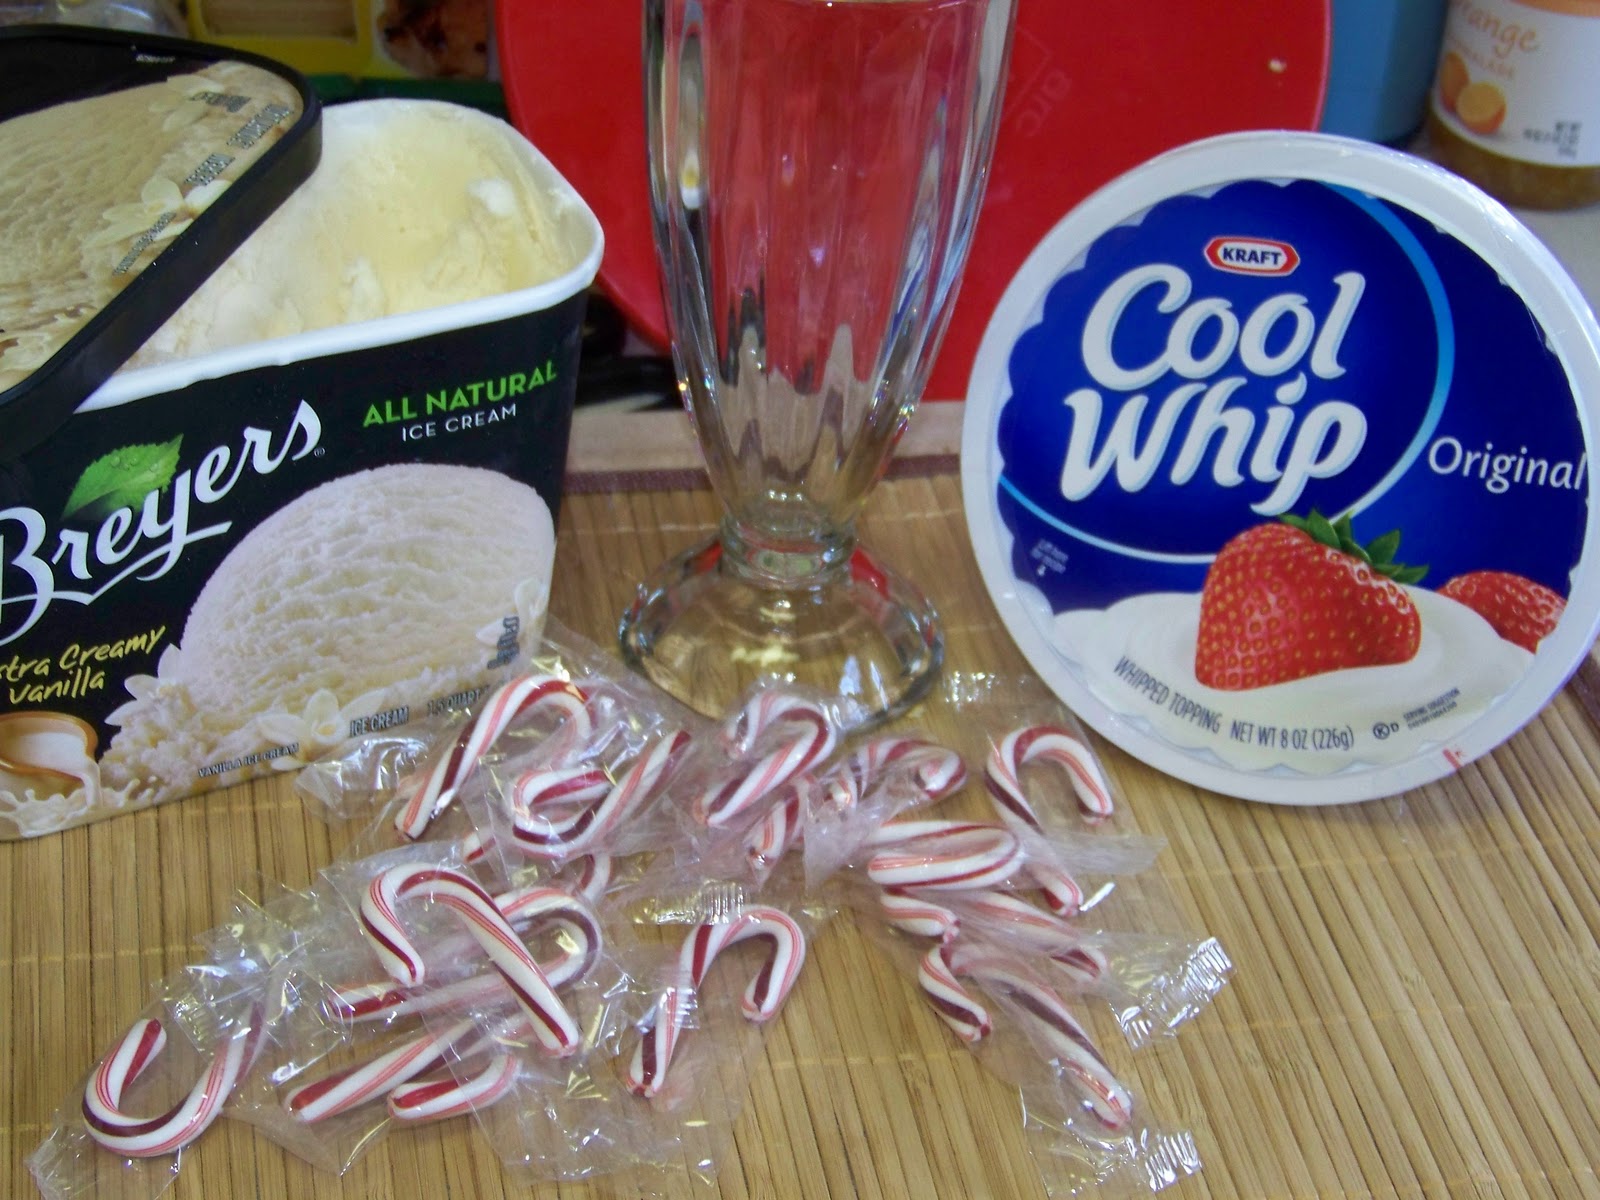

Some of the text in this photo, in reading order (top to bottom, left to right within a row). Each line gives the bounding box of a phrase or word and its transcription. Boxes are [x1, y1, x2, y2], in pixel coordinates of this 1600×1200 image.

[1222, 247, 1282, 265] KRAFT
[1082, 263, 1366, 391] Cool
[363, 360, 557, 428] ALL NATURAL
[402, 403, 517, 442] ICE CREAM
[1060, 372, 1368, 516] Whip
[1429, 436, 1587, 494] Original
[0, 400, 321, 645] Breyers
[59, 625, 166, 670] Creamy
[349, 704, 410, 737] ICE CREAM
[1114, 656, 1354, 751] WHIPPED TOPPING NET WT 8 OZ (226g)
[198, 757, 242, 778] VANILLA
